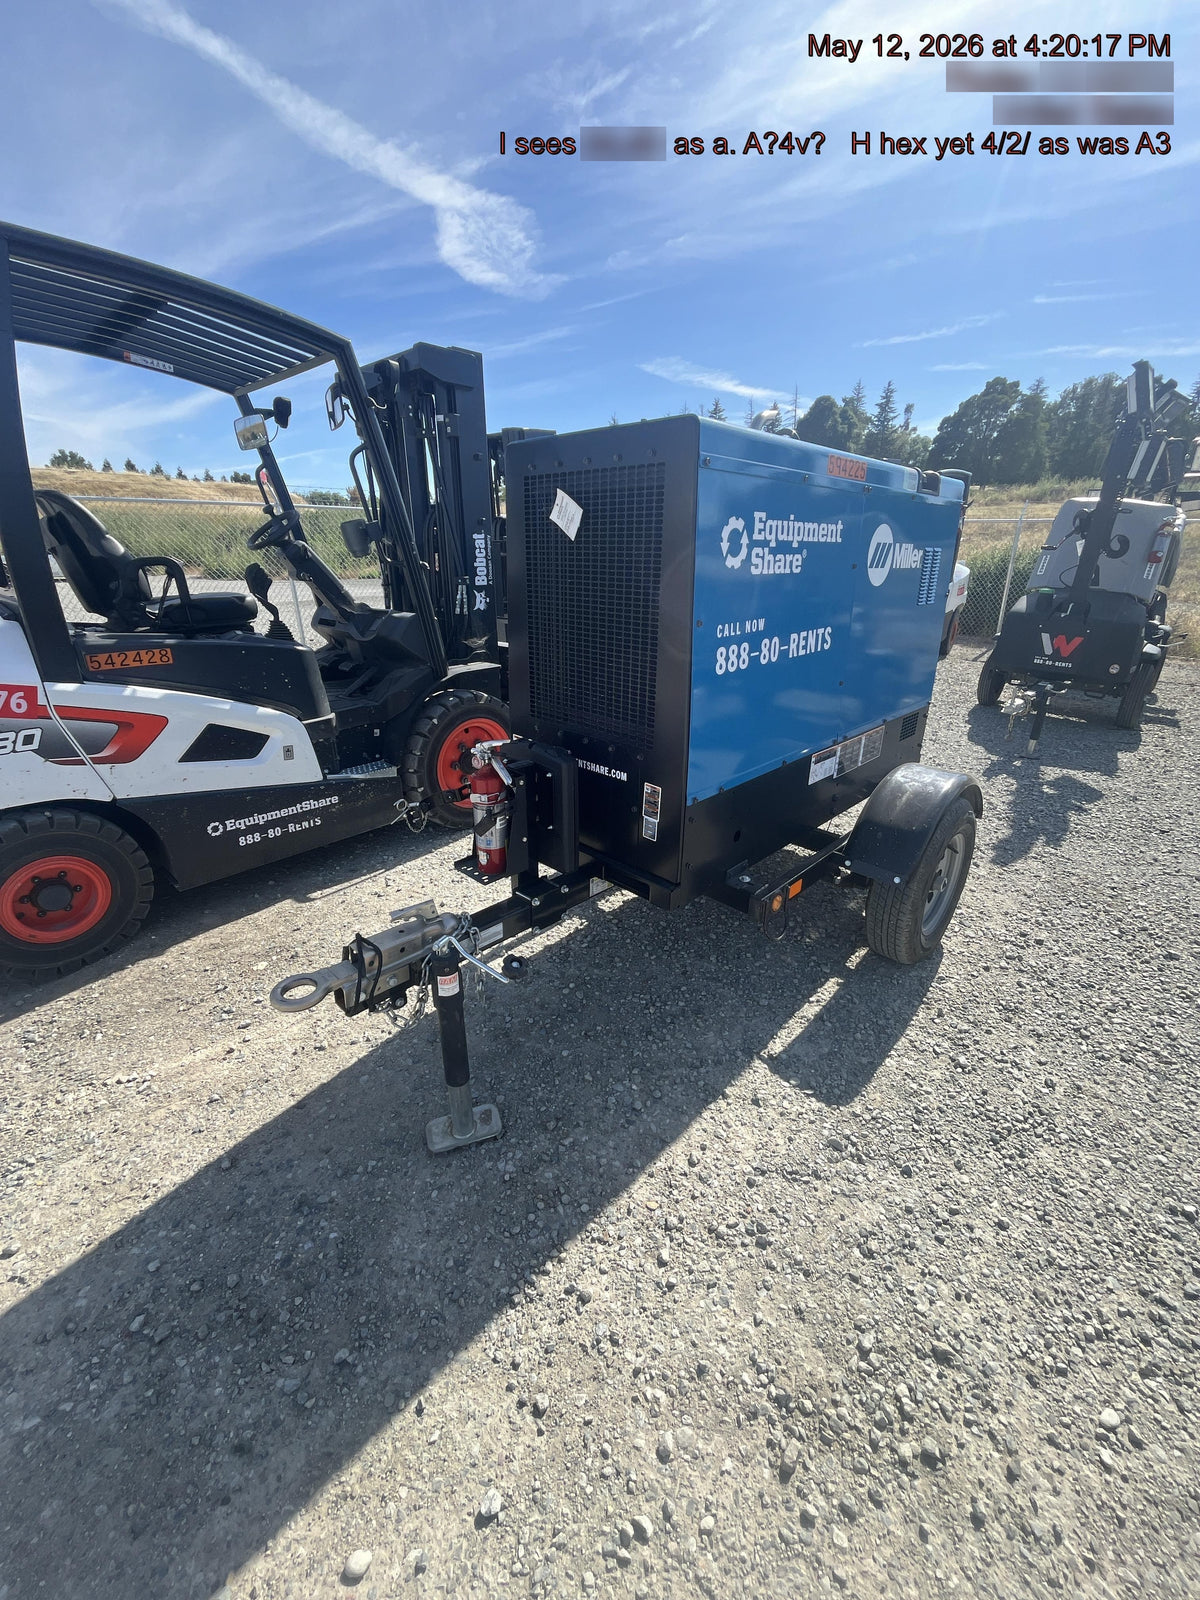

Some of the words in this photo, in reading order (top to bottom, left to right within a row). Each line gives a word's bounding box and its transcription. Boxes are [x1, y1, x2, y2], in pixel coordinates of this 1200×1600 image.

[828, 454, 867, 480] 594225
[752, 511, 843, 547] Equipment
[472, 533, 488, 586] Bobcat
[893, 542, 923, 569] Miller
[717, 622, 741, 639] CALL
[745, 618, 765, 633] NOW
[88, 648, 172, 670] 542428
[715, 626, 833, 675] 888-80-RENTS
[576, 758, 628, 782] NTSHARE.COM
[224, 796, 339, 831] EquipmentShare
[238, 817, 323, 846] 888-80-RENTS
